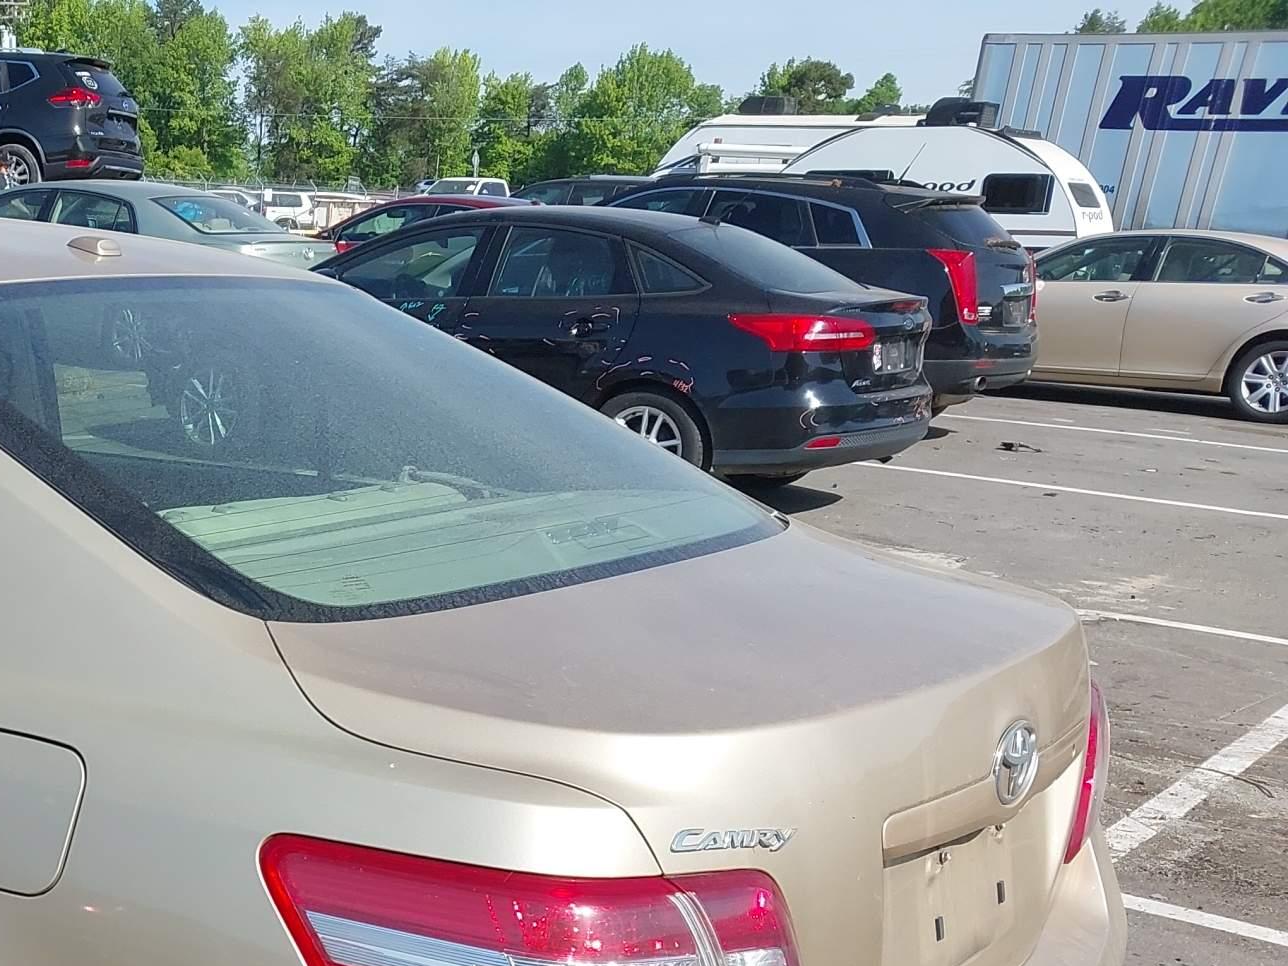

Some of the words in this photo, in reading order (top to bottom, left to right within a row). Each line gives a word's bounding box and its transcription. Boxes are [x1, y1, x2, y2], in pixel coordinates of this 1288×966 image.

[1099, 75, 1288, 131] RAV
[1081, 210, 1104, 223] r-pod
[669, 828, 798, 853] CAMRY
